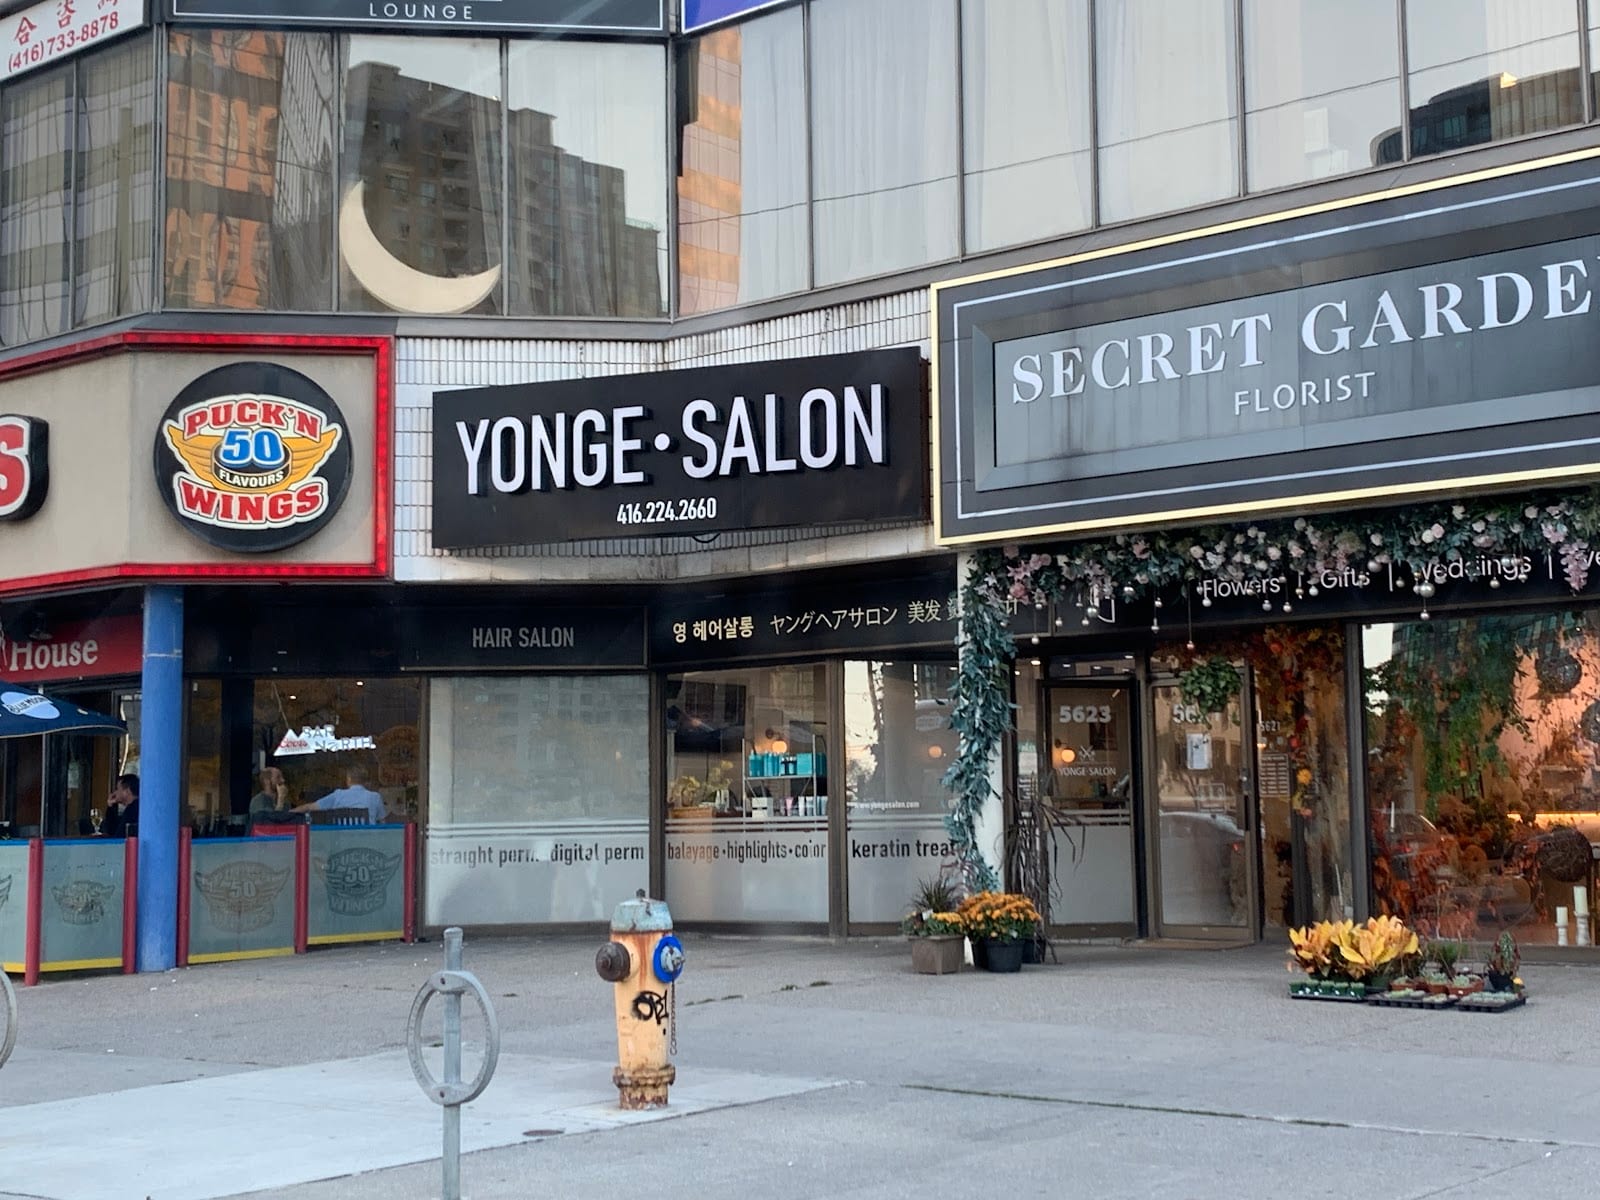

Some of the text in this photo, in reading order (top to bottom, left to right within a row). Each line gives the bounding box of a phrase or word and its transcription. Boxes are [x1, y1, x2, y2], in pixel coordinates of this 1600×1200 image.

[369, 3, 473, 20] LOUNGE
[1012, 257, 1600, 405] SECRET GARDE
[1235, 371, 1377, 416] FLORIST
[183, 400, 322, 443] PUCK'N
[681, 383, 886, 480] SALON
[219, 428, 285, 467] 50
[219, 470, 285, 488] FLAVOURS
[180, 479, 323, 523] WINGS
[616, 497, 717, 525] 416.224.2660
[672, 616, 755, 643] 영 헤어살롱
[770, 606, 898, 636] ヤングヘアサロン
[472, 627, 574, 648] HAIR SALON
[9, 640, 98, 671] House
[1059, 705, 1112, 724] 5623
[605, 845, 645, 865] perm
[795, 839, 827, 859] coor
[852, 839, 911, 858] keratin
[343, 866, 371, 884] 50
